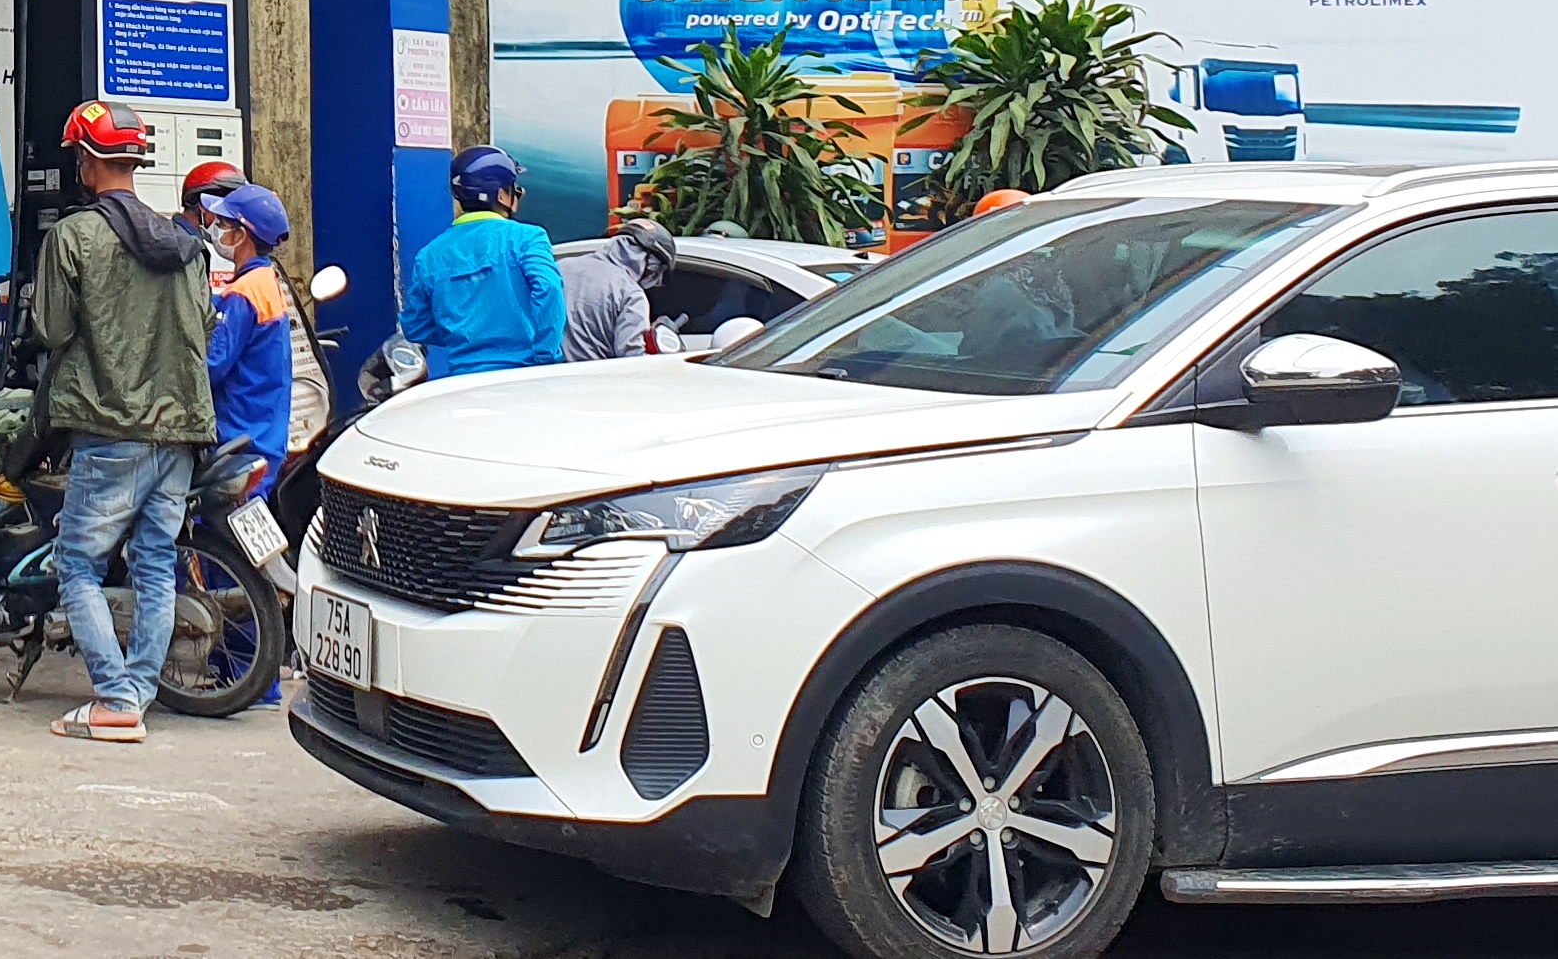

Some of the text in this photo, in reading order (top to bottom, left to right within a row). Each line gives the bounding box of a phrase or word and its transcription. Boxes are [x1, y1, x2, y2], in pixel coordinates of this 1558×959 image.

[685, 10, 780, 30] powered
[326, 598, 351, 639] 75A
[315, 632, 361, 680] 228.90
